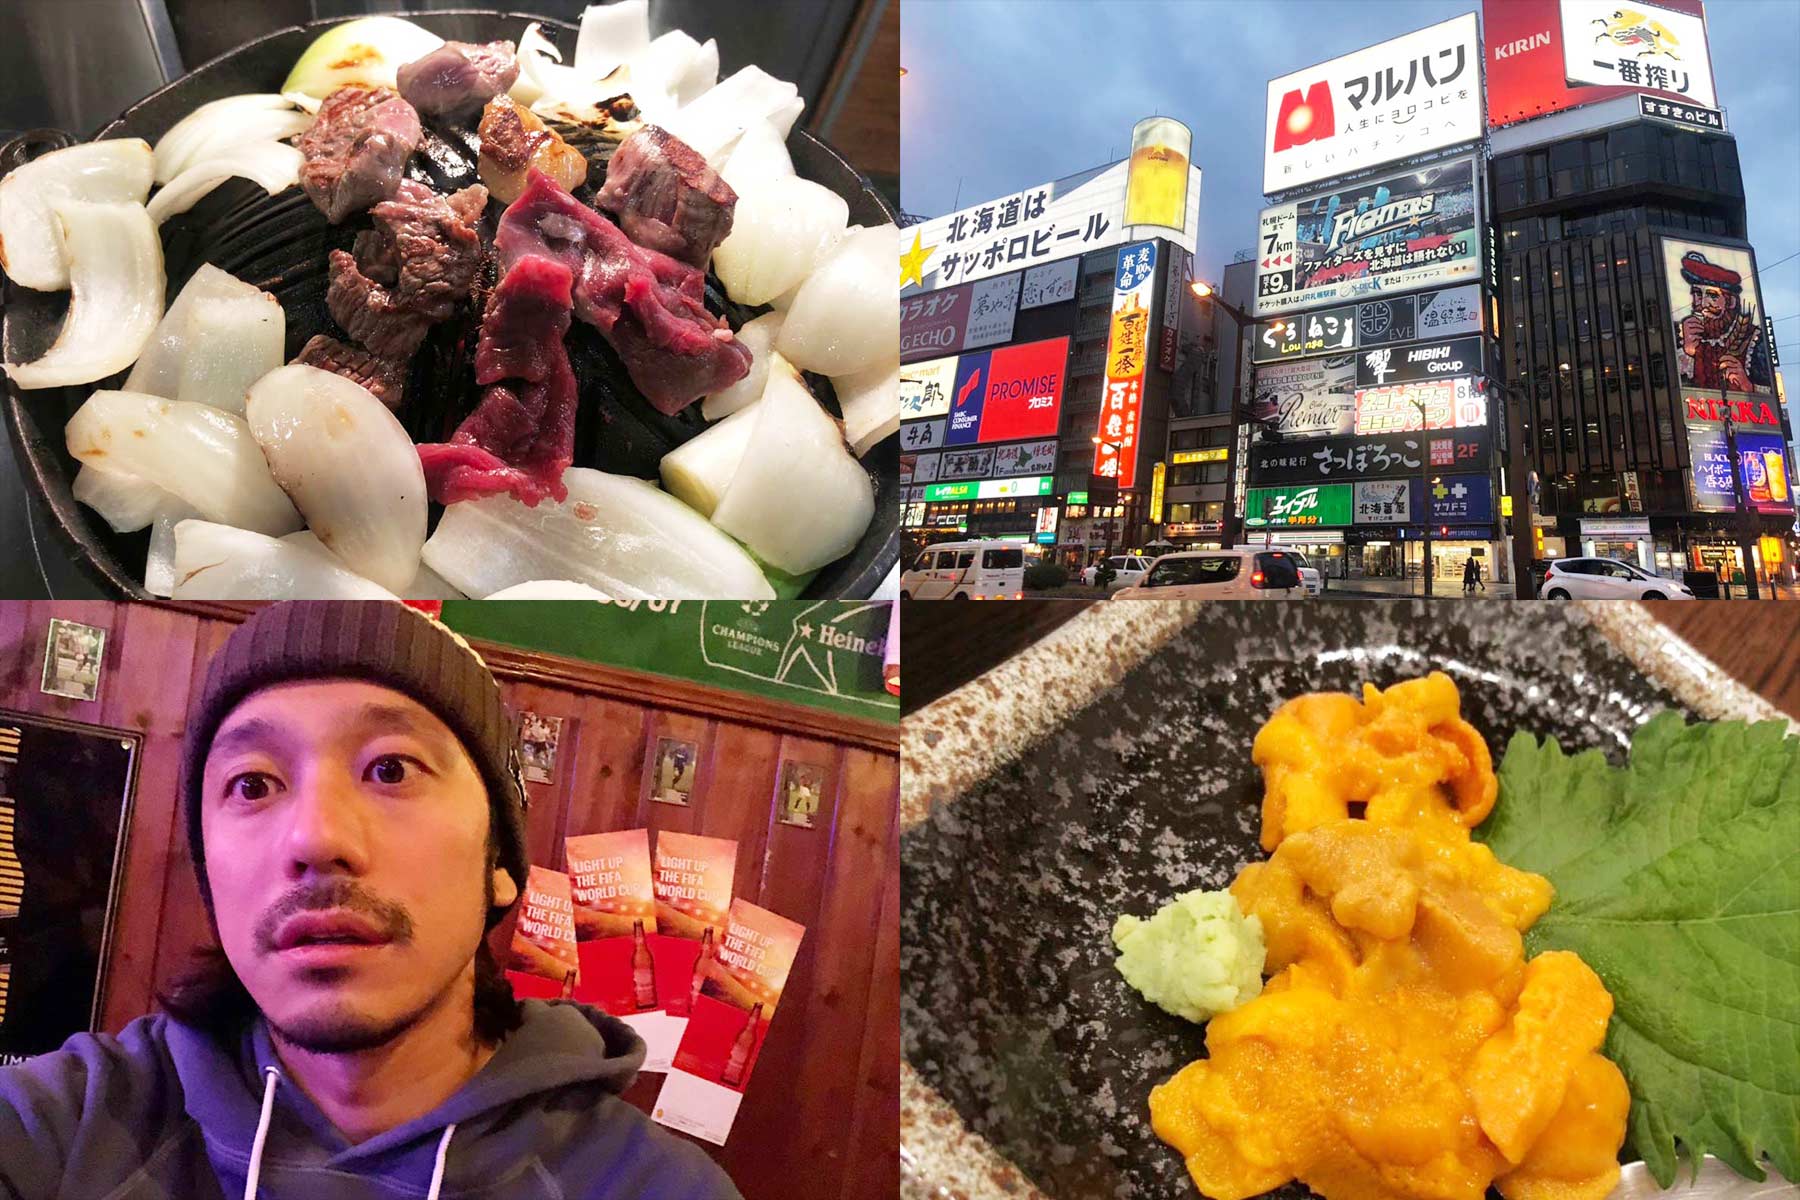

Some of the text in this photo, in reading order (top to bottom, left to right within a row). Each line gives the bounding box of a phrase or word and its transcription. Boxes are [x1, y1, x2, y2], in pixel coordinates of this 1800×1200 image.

[1494, 31, 1551, 60] KIRIN
[1344, 44, 1465, 111] マルハン
[1593, 57, 1690, 93] 一番搾り
[1344, 89, 1469, 134] 人生にヨロコビを
[1645, 101, 1719, 126] すすきのビル
[946, 190, 1047, 244] 北海道は
[1326, 194, 1435, 254] FIGHTERS
[941, 211, 1111, 281] サッポロビール
[1263, 233, 1293, 255] 7km
[1303, 241, 1407, 273] ファイターズを見ずに
[1120, 254, 1136, 288] 革命
[1390, 326, 1415, 341] EVE
[1408, 346, 1451, 362] HIBIKI
[1427, 360, 1463, 373] Group
[991, 374, 1057, 402] PROMISE
[1028, 396, 1054, 409] プロミス
[907, 423, 933, 446] 牛角
[1260, 456, 1307, 469] 北の味紀行
[1312, 440, 1421, 475] さっぽろっこ
[1457, 443, 1479, 458] 2F
[1269, 488, 1319, 516] エイブル
[712, 623, 780, 653] CHAMPIONS
[727, 639, 763, 657] LEAGUE
[573, 856, 624, 873] LIGHT UP
[661, 857, 709, 872] LIGHT UP
[575, 871, 622, 887] THE FIFA
[660, 870, 704, 886] THE FIFA
[528, 891, 574, 912] LIGHT U
[575, 883, 641, 902] WORLD CUP
[658, 883, 695, 899] WORLD
[526, 905, 573, 927] THE FIFA
[522, 920, 562, 939] WORLD
[729, 922, 775, 947] LIGHT UP
[725, 935, 767, 960] THE FIFA
[719, 948, 755, 971] WORLD
